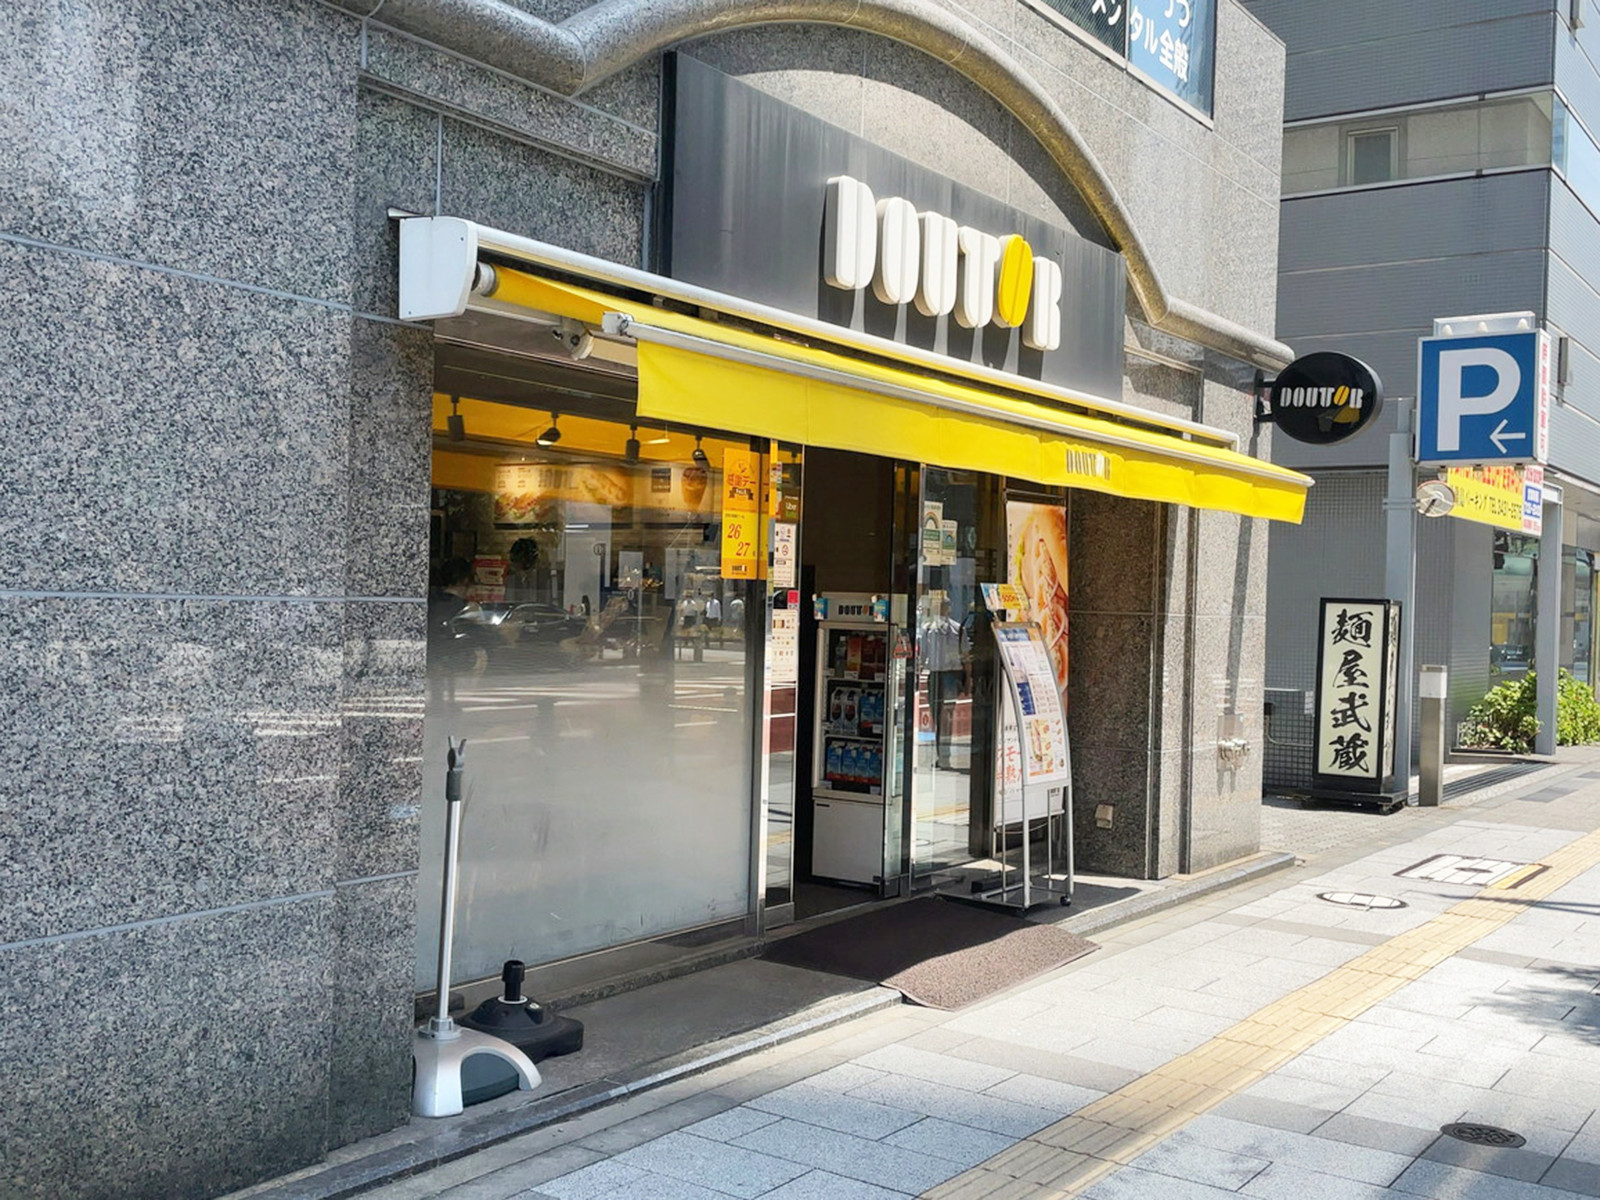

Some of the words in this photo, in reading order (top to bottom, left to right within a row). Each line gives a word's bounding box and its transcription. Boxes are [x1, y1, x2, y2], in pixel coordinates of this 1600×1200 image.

[823, 174, 1063, 351] DOUTOR
[1279, 385, 1364, 409] DOUTOR
[1437, 347, 1522, 452] P
[727, 522, 742, 540] 26
[735, 540, 751, 557] 27
